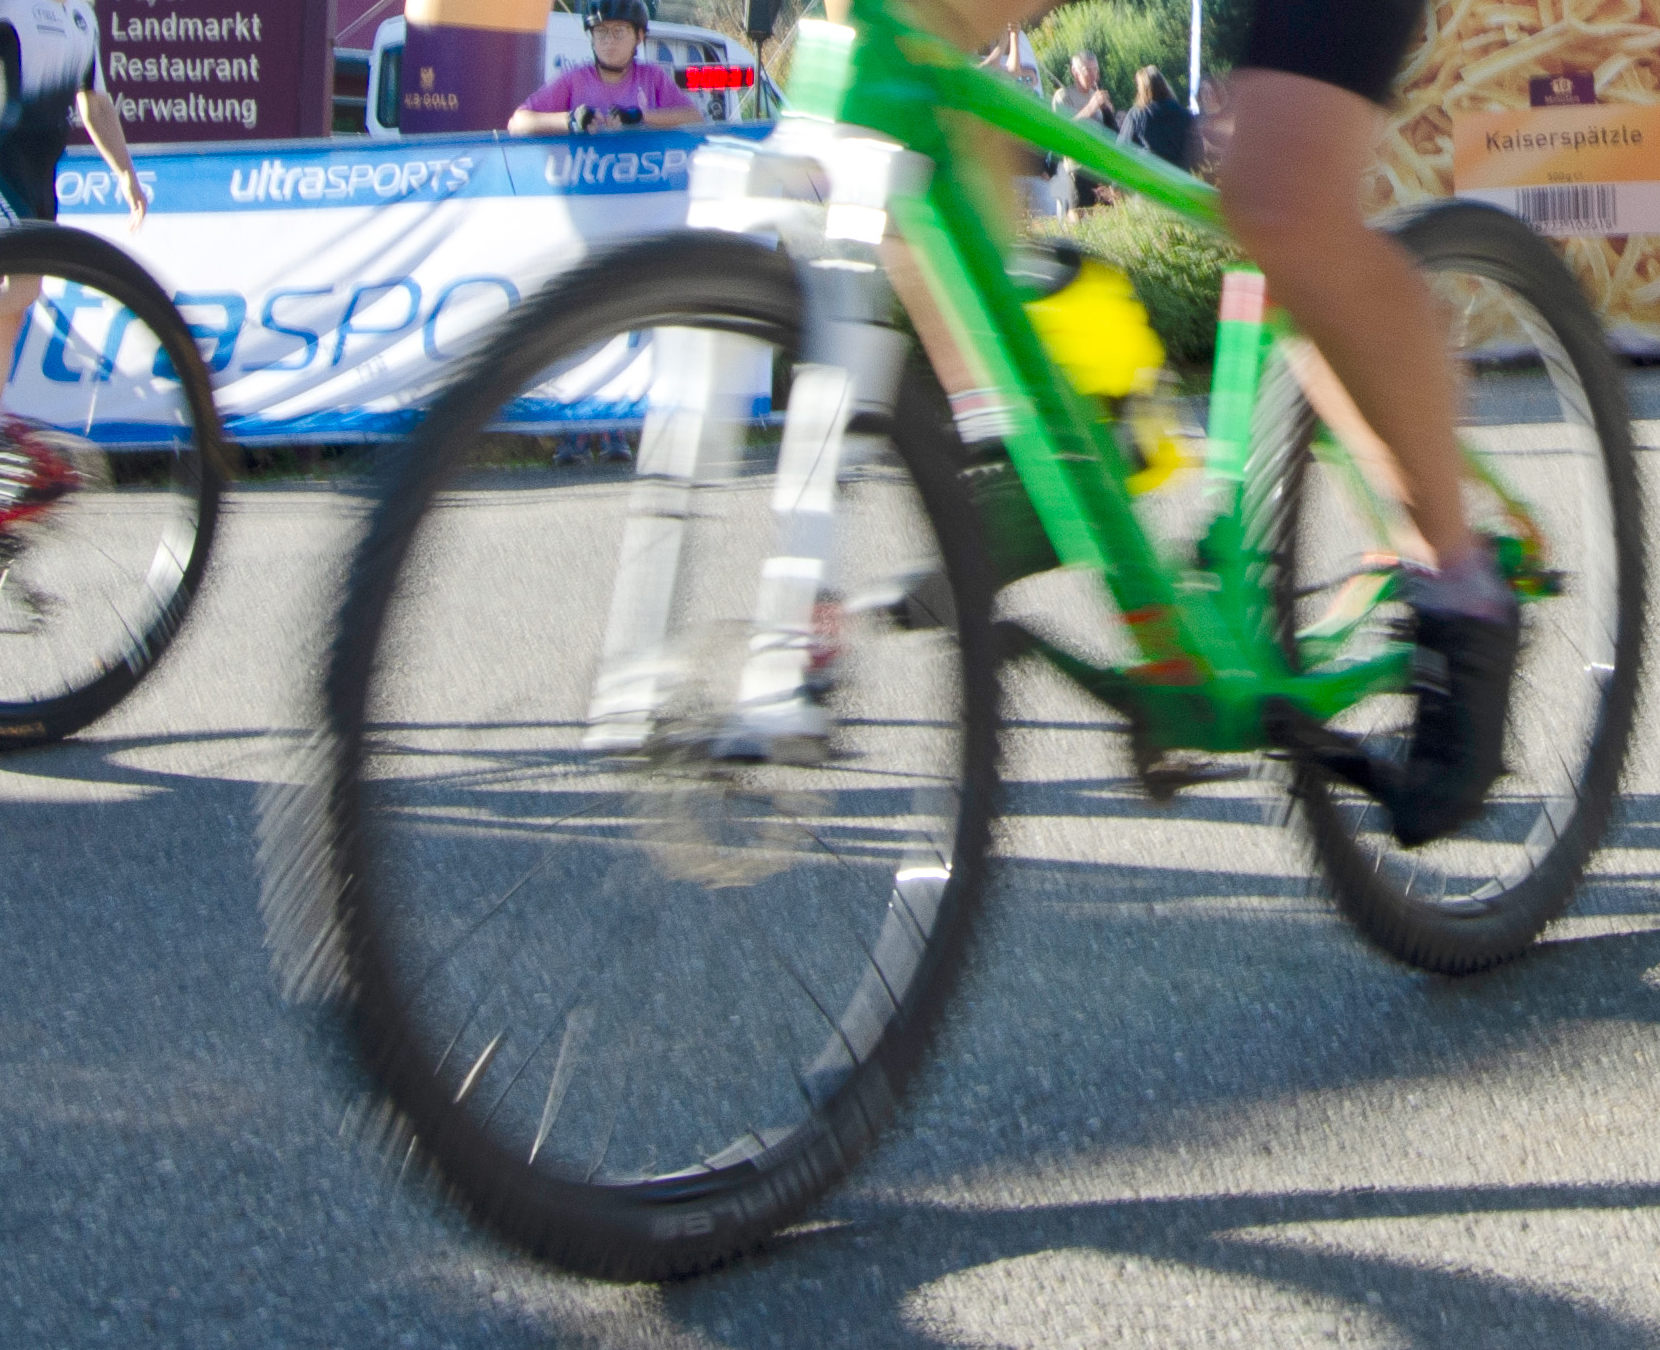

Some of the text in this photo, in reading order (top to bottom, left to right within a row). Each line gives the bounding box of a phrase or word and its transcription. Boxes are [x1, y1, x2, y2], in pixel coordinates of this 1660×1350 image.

[111, 11, 262, 42] Landmarkt
[109, 51, 260, 82] Restaurant
[1485, 125, 1643, 152] Kaiserspätzle
[230, 157, 474, 203] ultraSPORTS
